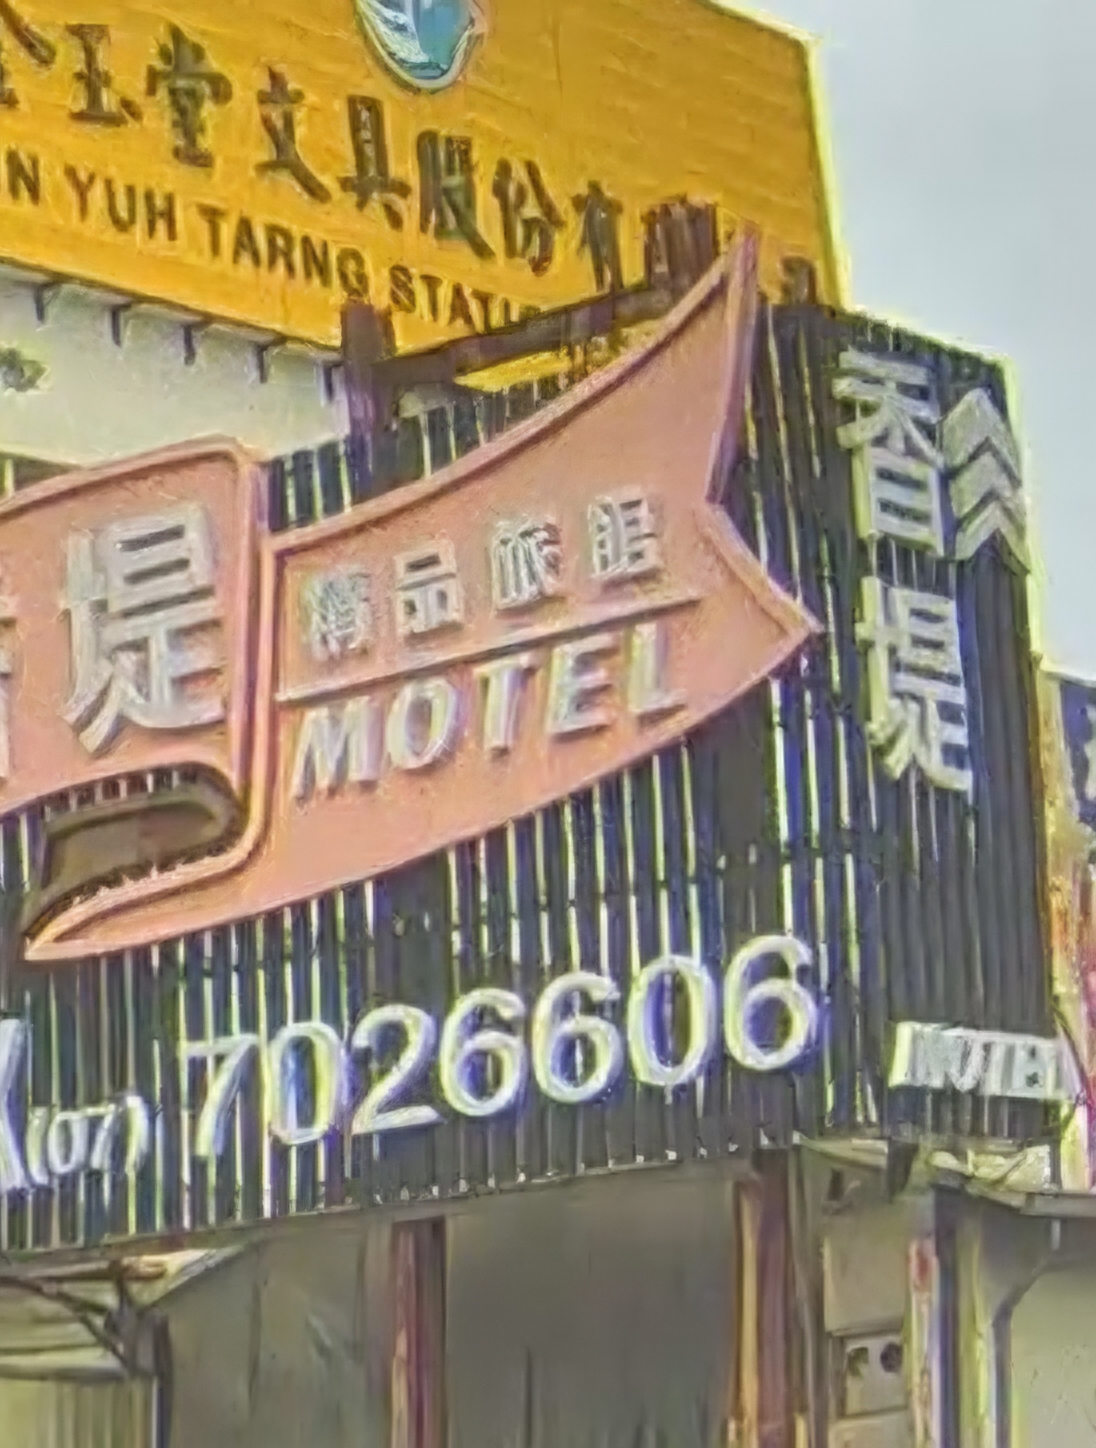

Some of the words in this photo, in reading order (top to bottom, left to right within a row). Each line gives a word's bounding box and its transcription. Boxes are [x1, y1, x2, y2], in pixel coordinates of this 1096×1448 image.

[63, 162, 179, 243] YUH
[196, 201, 370, 302] TARNG
[290, 620, 689, 801] MOTEL
[25, 1094, 150, 1186] (07)
[184, 934, 821, 1158] 7026606
[887, 1020, 1082, 1102] MOTEL
